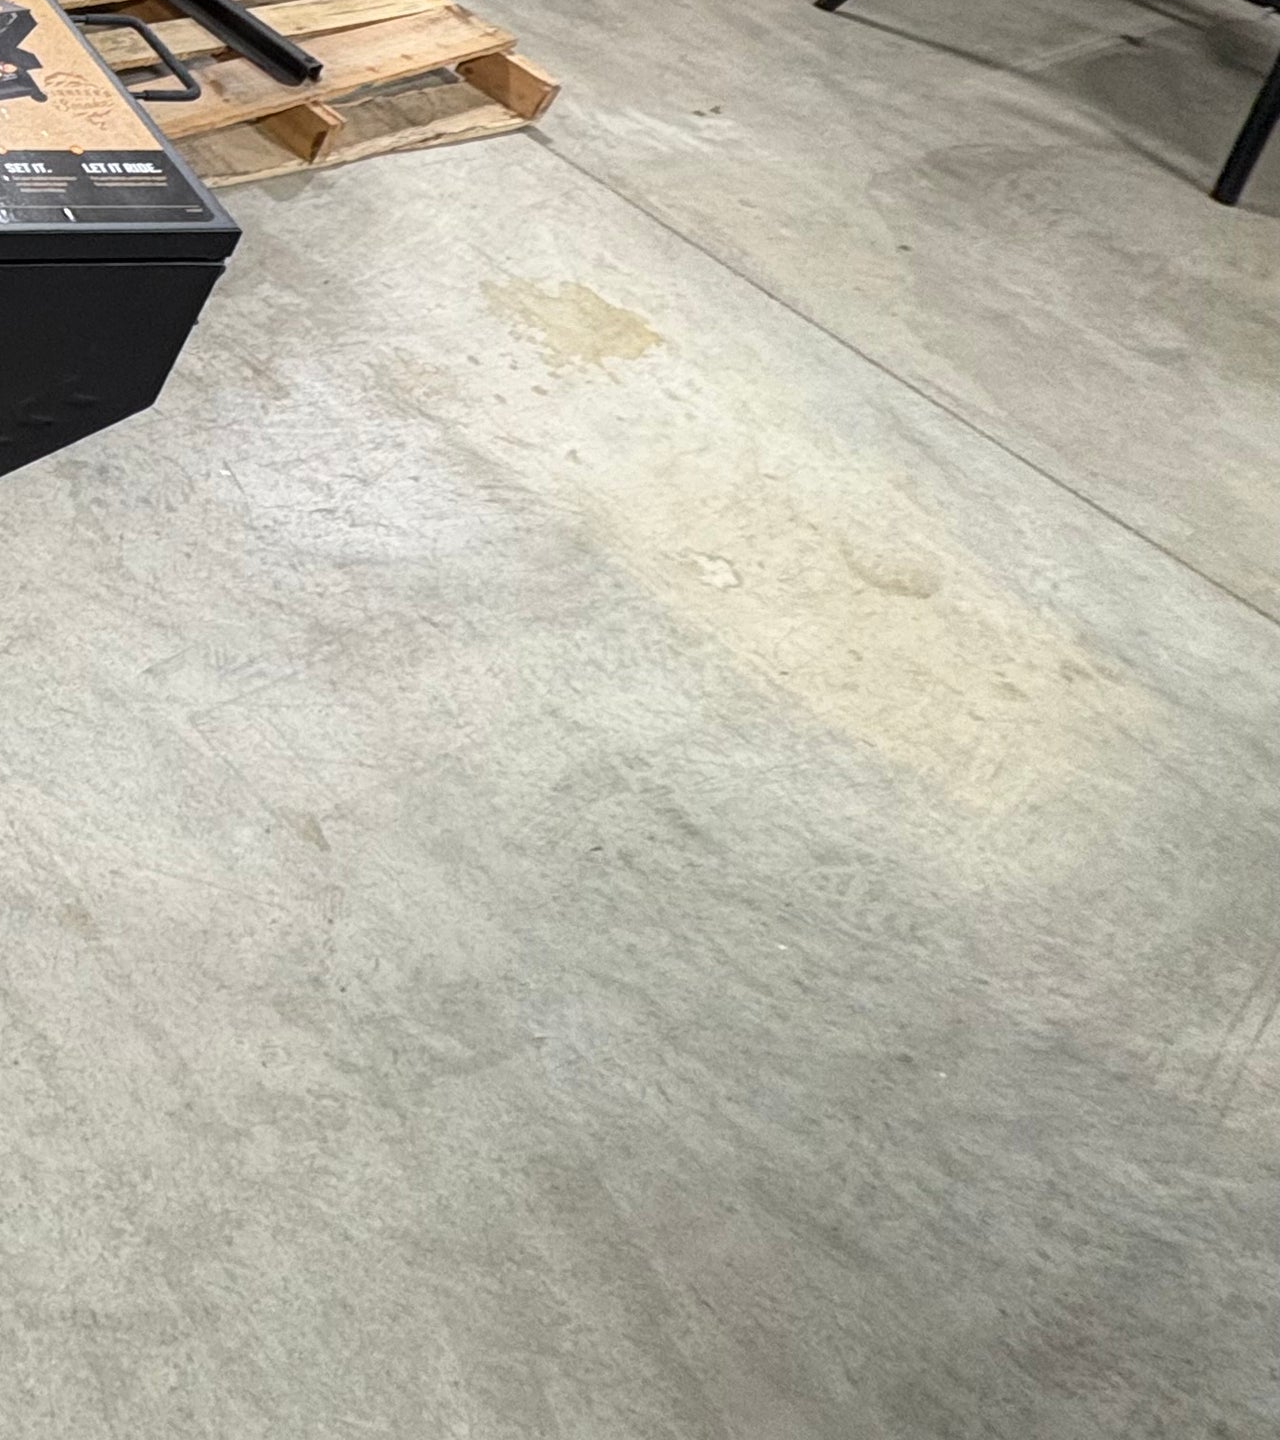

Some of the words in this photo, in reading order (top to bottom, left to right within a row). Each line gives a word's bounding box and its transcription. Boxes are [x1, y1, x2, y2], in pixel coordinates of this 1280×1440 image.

[5, 162, 31, 173] SET
[33, 162, 53, 174] IT.
[82, 162, 107, 173] LET
[108, 162, 123, 173] IT
